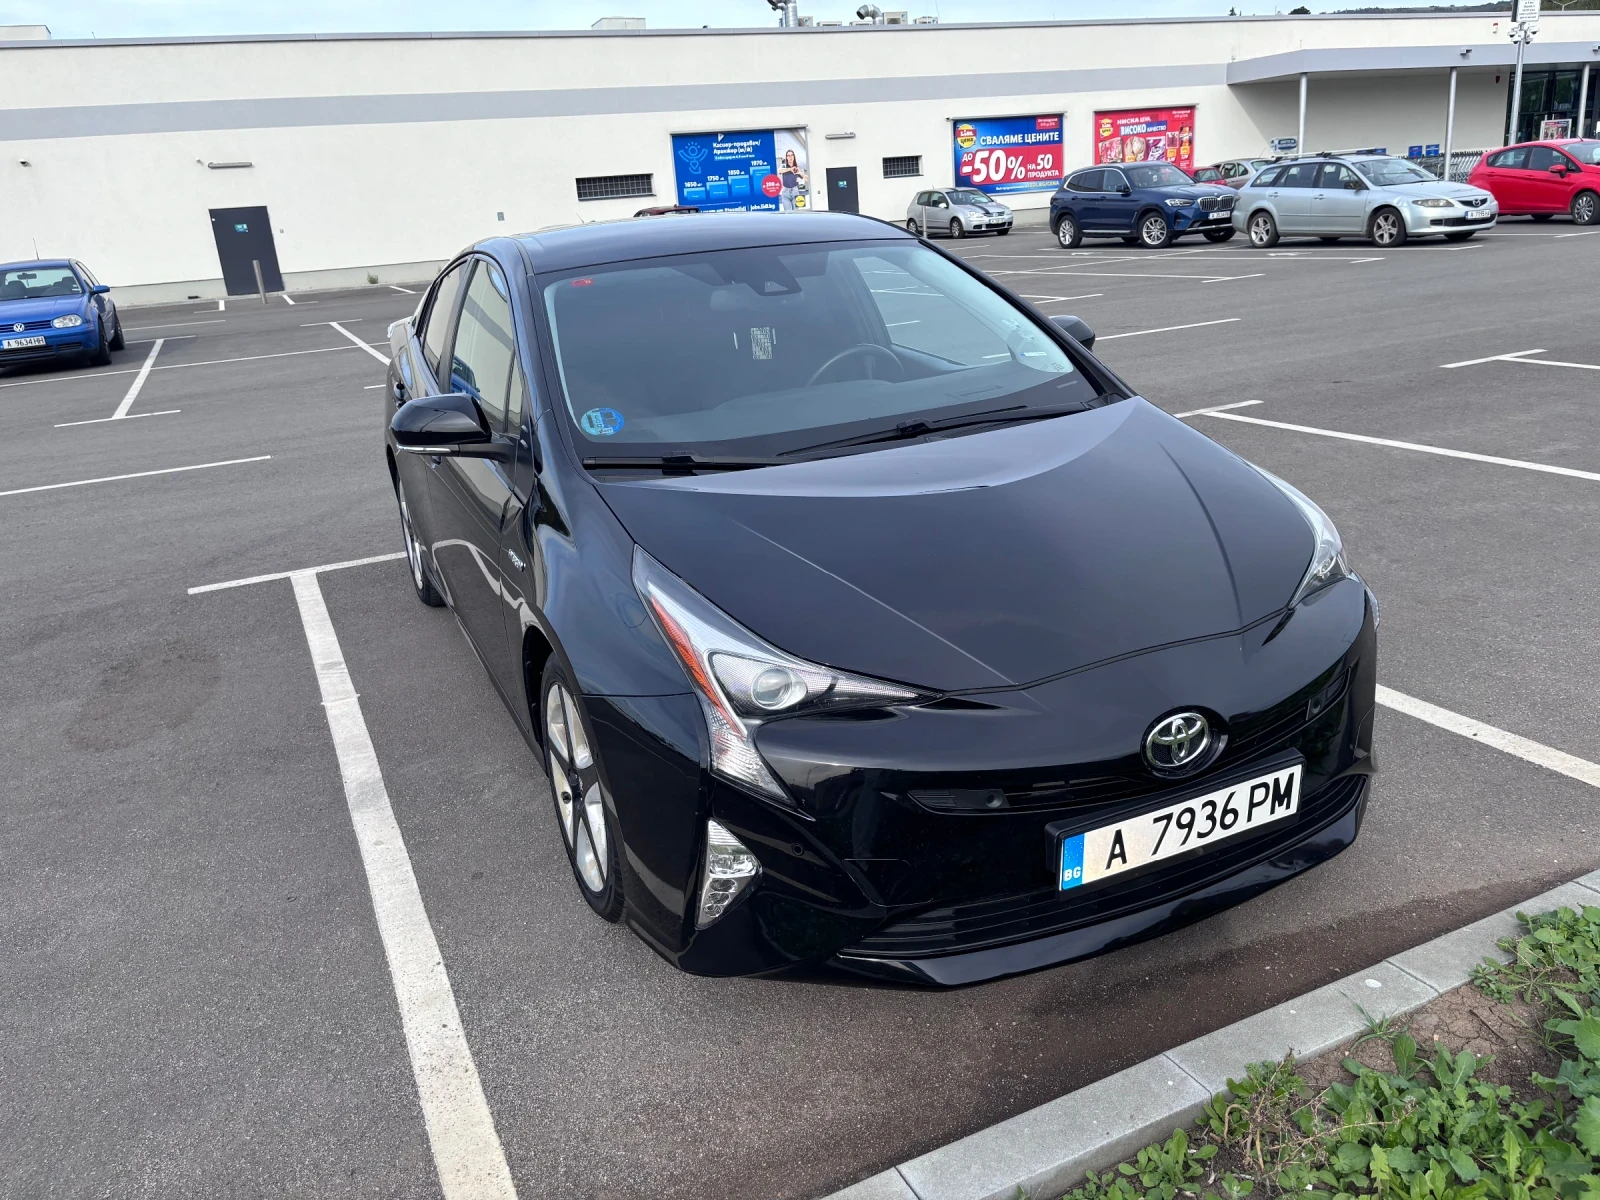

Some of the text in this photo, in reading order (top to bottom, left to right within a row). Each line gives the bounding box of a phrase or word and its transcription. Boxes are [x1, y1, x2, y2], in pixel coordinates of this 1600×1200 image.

[1117, 117, 1139, 125] НИСКА
[1120, 123, 1146, 136] ВИСОКО
[980, 131, 1059, 145] СВАЛЯМЕ ЦЕНИТЕ
[962, 152, 973, 162] ДО
[1027, 153, 1053, 170] НА 50
[961, 149, 1026, 183] -50%
[1027, 169, 1059, 179] ПРОДУКТА
[14, 338, 33, 346] 9634
[1105, 772, 1295, 870] A 7936 PM
[1063, 866, 1082, 881] BG
